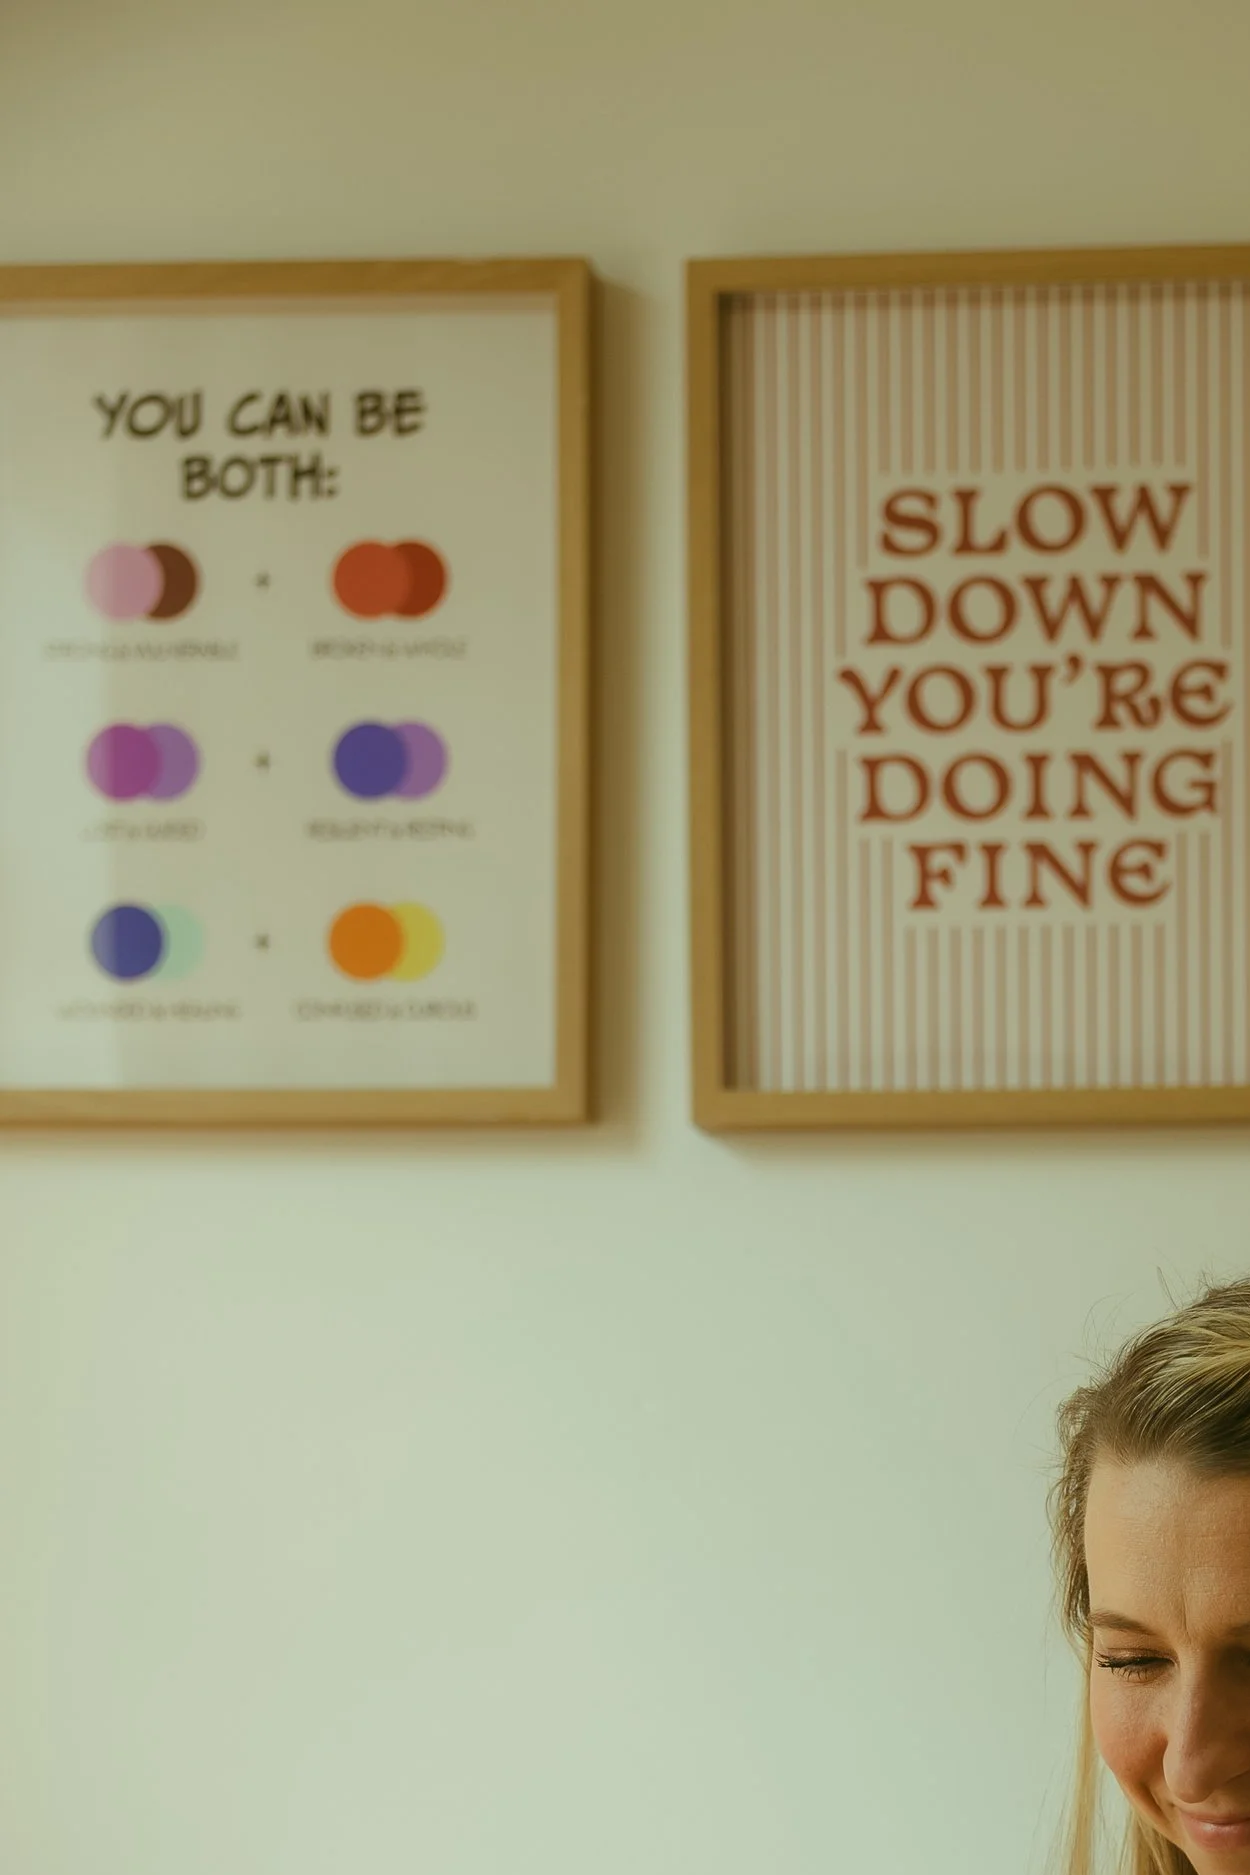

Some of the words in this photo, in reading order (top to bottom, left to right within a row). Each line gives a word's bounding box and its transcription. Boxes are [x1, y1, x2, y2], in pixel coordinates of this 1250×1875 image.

[93, 392, 202, 440] YOU
[228, 392, 329, 437] CAN
[355, 390, 427, 437] BE
[182, 454, 339, 500] BOTH:
[881, 483, 1192, 557] SLOW
[866, 571, 1207, 645] DOWN
[837, 652, 1233, 735] YOU'RE
[861, 750, 1218, 821] DOING
[909, 838, 1169, 909] FINE
